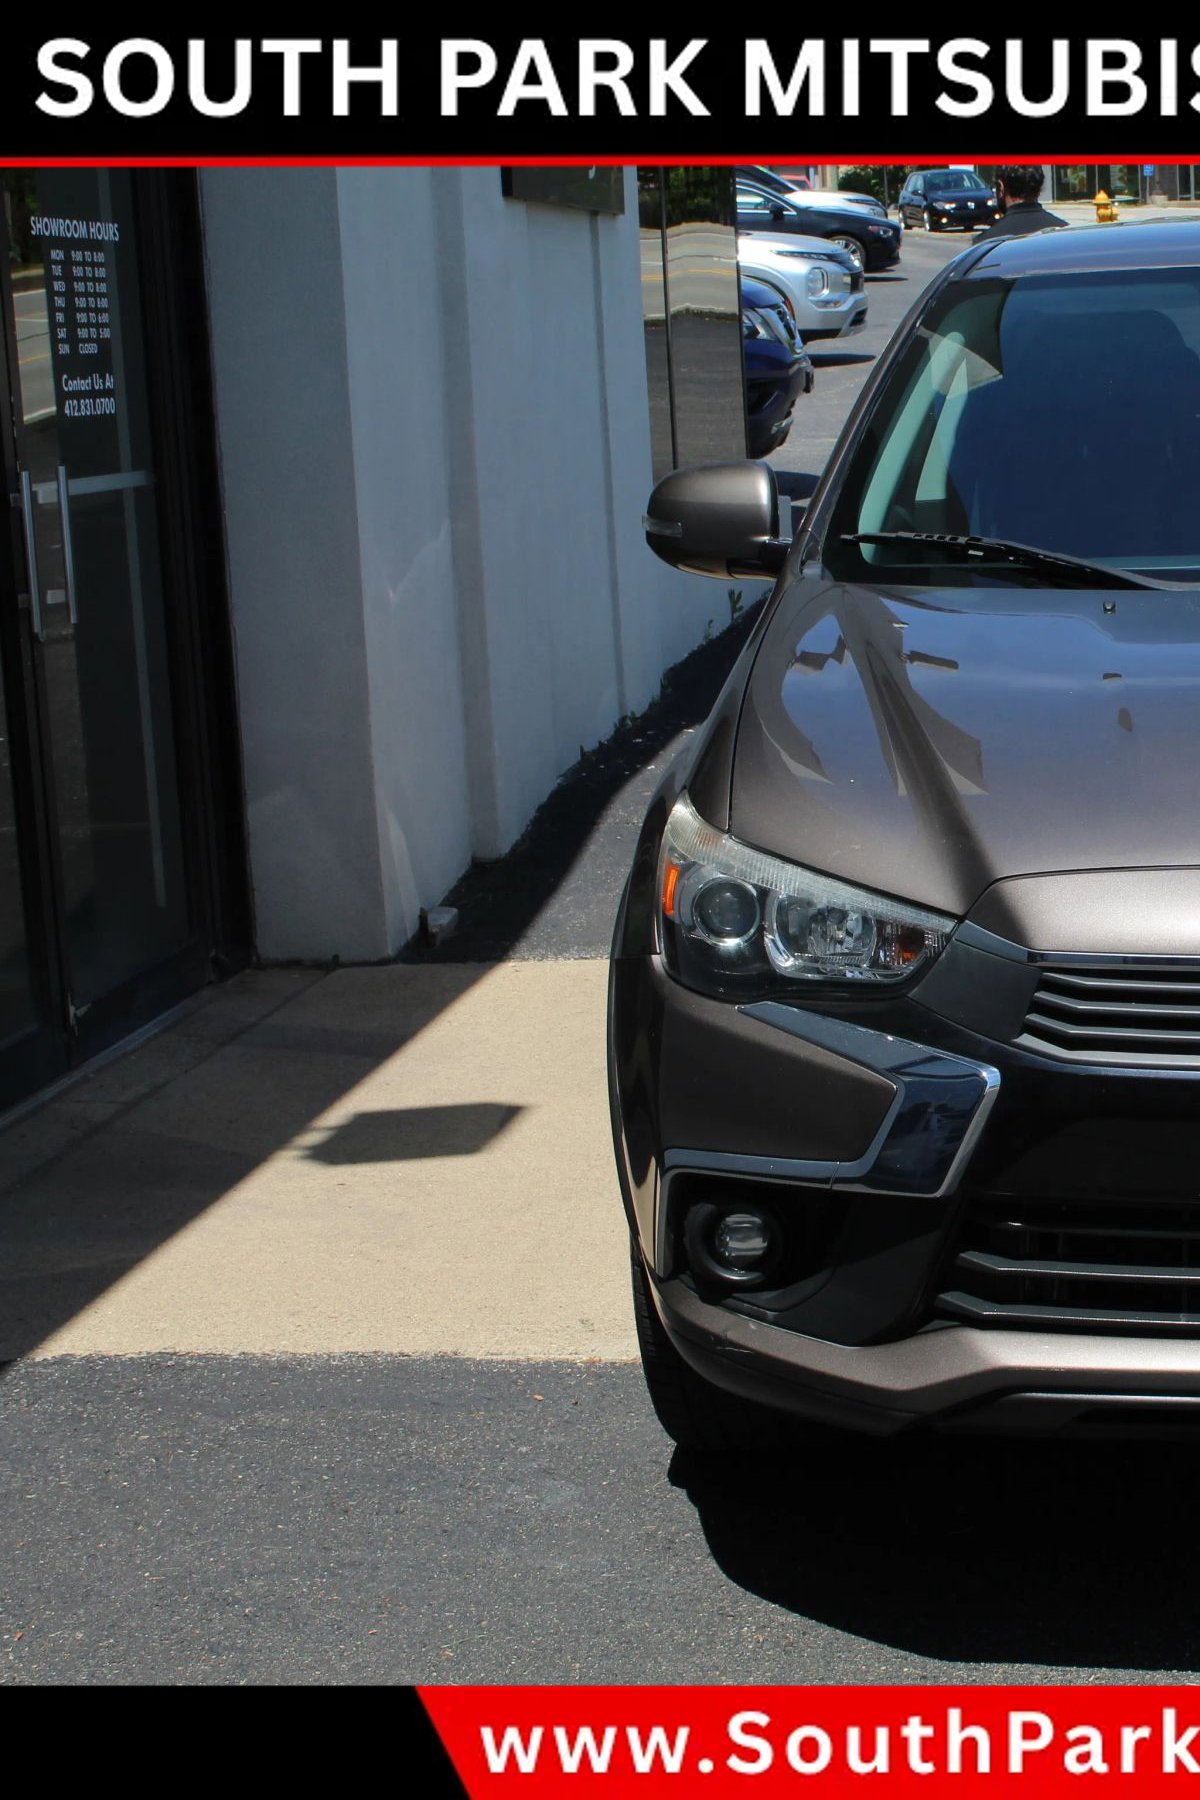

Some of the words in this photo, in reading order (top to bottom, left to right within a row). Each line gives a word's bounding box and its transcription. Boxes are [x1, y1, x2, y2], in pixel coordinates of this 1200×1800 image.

[30, 216, 88, 238] SHOWROOM
[89, 222, 119, 241] HOURS
[50, 249, 65, 261] MON
[84, 251, 92, 262] TO
[52, 265, 62, 276] TUE
[85, 266, 93, 277] TO
[53, 281, 66, 292] WED
[86, 282, 95, 293] TO
[54, 297, 65, 308] THU
[88, 297, 96, 308] TO
[55, 312, 65, 323] FRI
[76, 312, 88, 323] 9:00
[89, 312, 97, 323] TO
[57, 328, 67, 339] SAT
[77, 328, 89, 338] 9:00
[90, 328, 97, 338] TO
[58, 343, 70, 355] SUN
[79, 343, 98, 354] CLOSED
[62, 374, 92, 391] Contact
[93, 374, 103, 390] Us
[105, 374, 114, 389] At
[64, 398, 116, 416] 412.831.0700
